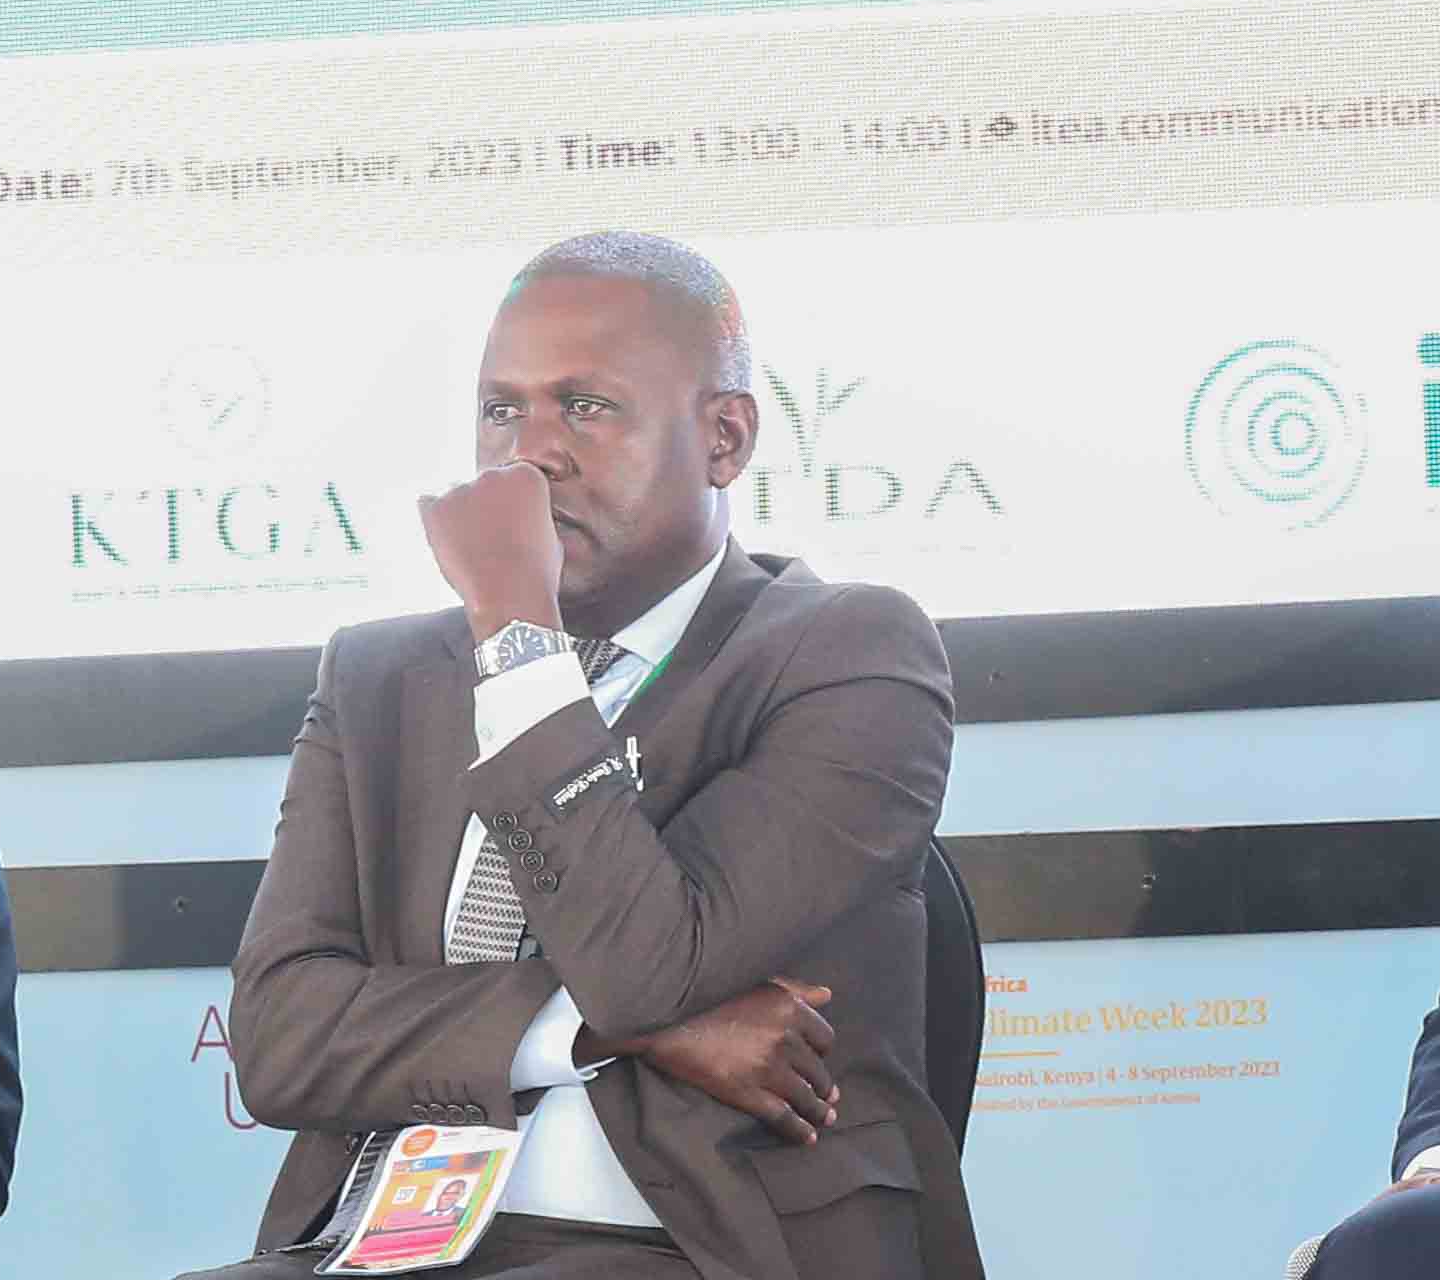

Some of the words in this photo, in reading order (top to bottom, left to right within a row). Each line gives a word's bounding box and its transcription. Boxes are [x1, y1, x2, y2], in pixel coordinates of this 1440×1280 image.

[109, 156, 173, 199] 7th
[182, 144, 411, 201] September,
[427, 135, 521, 182] 2023
[557, 131, 675, 174] Time:
[692, 121, 799, 167] 13:00
[842, 114, 946, 158] 14:00
[747, 456, 1005, 526] TDA
[69, 479, 365, 568] KTGA
[984, 975, 1028, 993] frica
[986, 1008, 1091, 1037] limate
[1098, 1002, 1188, 1031] Week
[1195, 998, 1268, 1026] 2023
[1043, 1068, 1094, 1087] Kenya
[1107, 1066, 1116, 1081] 4
[1141, 1063, 1234, 1086] September
[1239, 1060, 1280, 1077] 2023
